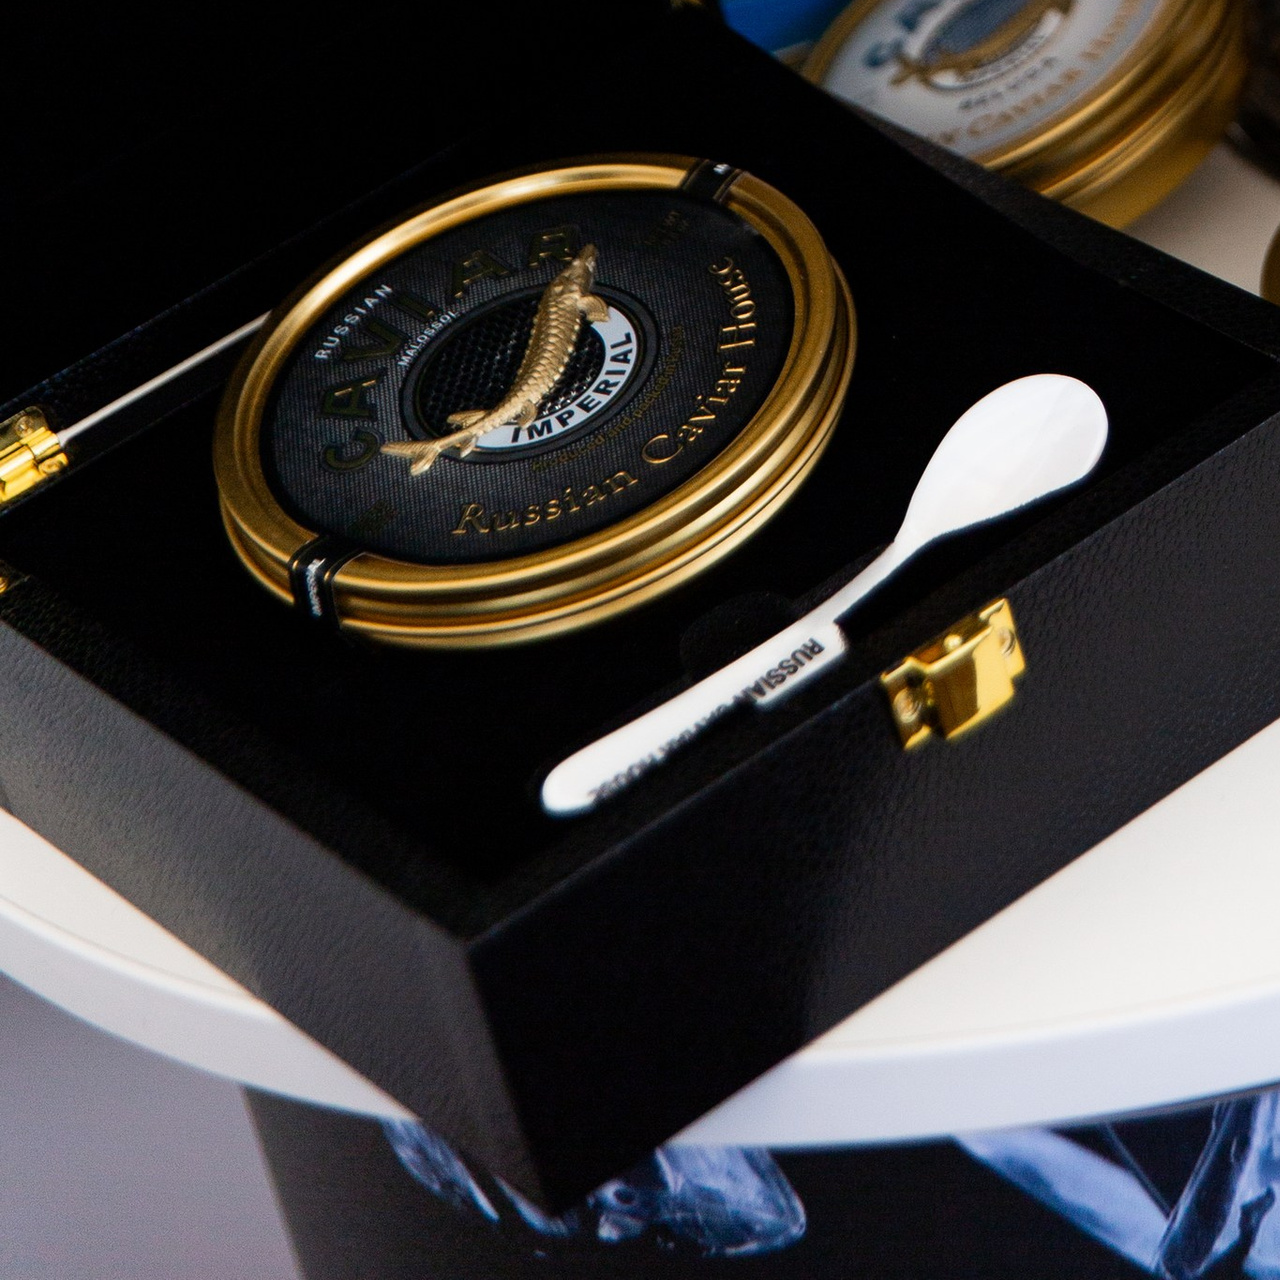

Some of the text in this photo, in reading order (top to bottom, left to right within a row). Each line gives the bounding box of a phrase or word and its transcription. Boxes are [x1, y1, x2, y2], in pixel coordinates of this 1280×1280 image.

[314, 283, 394, 361] RUSSIAN
[317, 223, 580, 472] CAVIAR
[396, 309, 461, 369] MALOSSOL
[452, 468, 639, 535] Russian
[640, 361, 747, 464] Caviar
[707, 255, 759, 354] House
[511, 331, 635, 444] IMPERIAL
